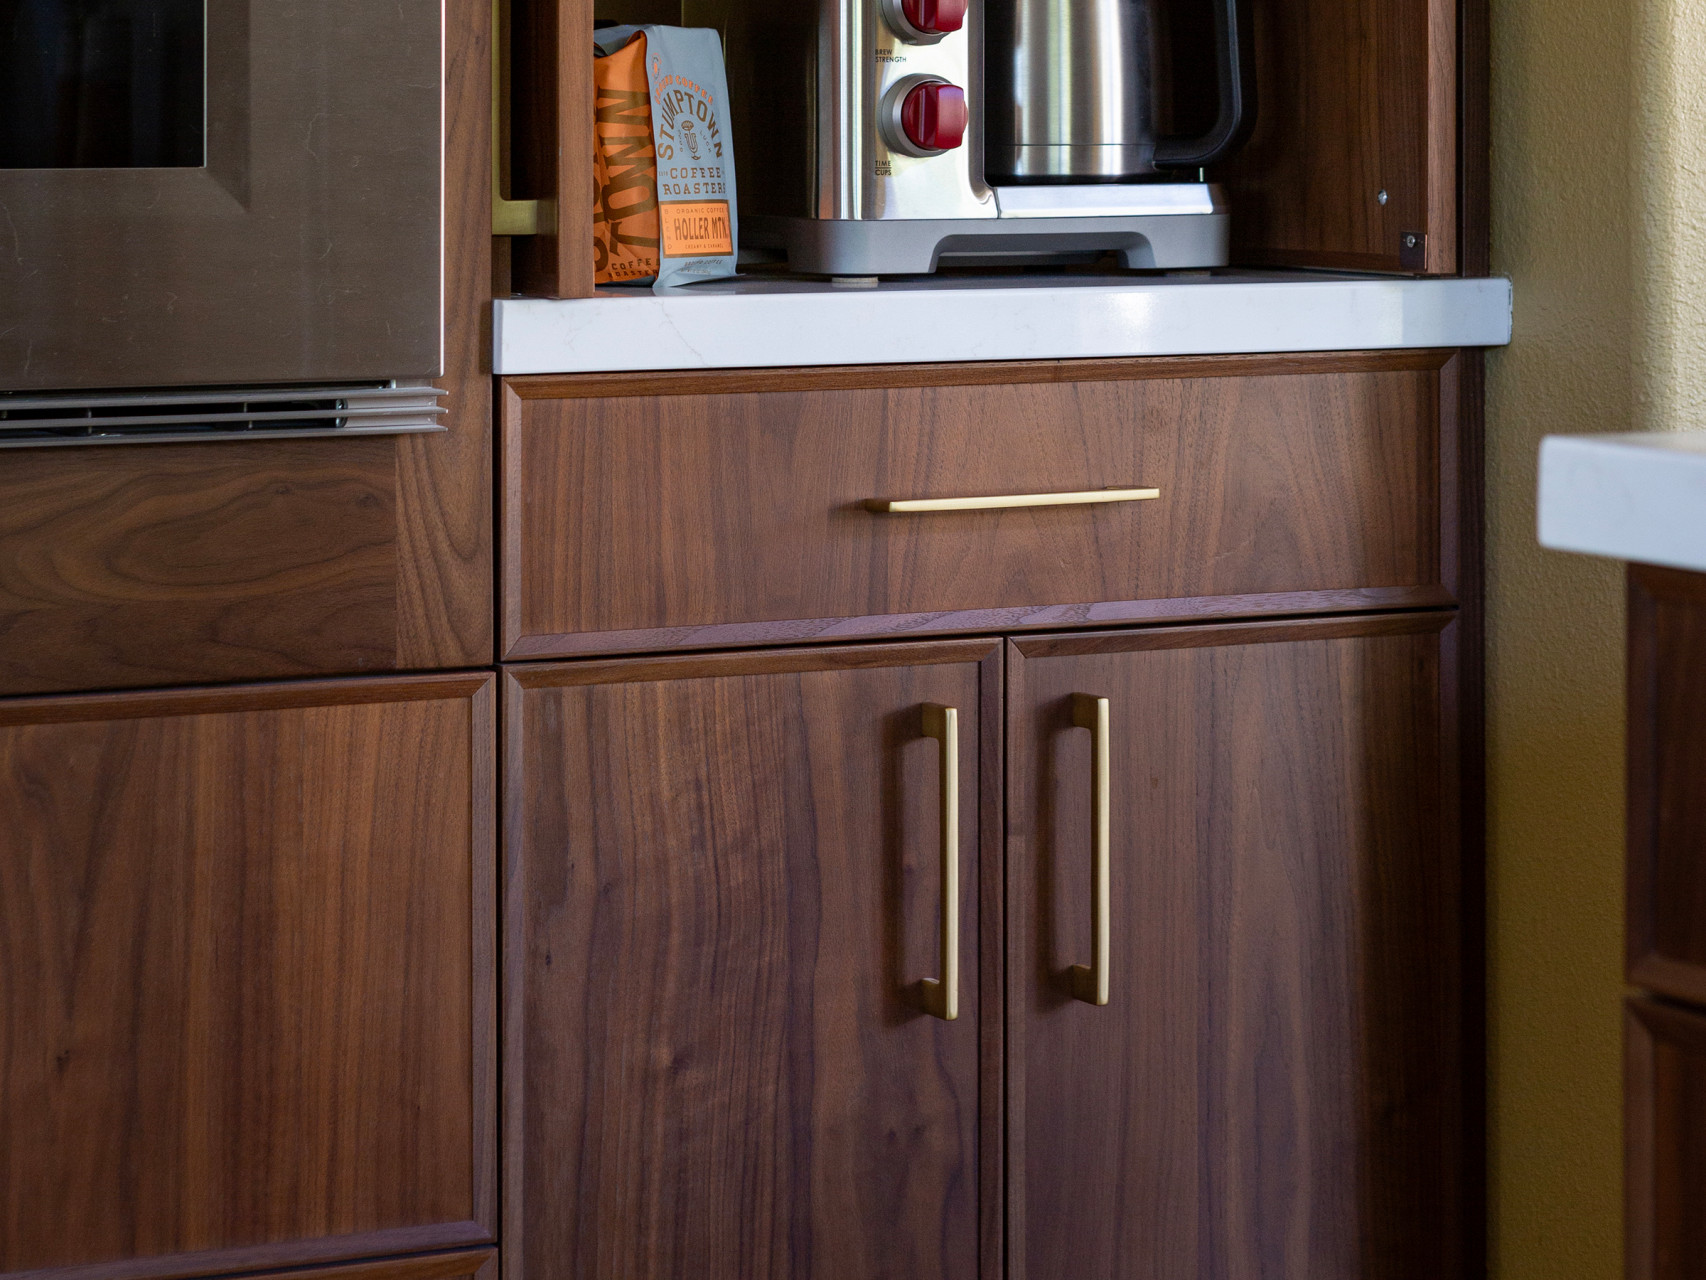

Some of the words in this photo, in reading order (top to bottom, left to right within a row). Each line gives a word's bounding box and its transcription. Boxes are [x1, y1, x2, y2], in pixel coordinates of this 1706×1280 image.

[875, 48, 893, 56] BREW
[657, 89, 723, 161] STUMPTOWN
[669, 167, 722, 179] COFFEE
[663, 182, 726, 195] ROASTERS
[674, 217, 710, 241] HOLLER
